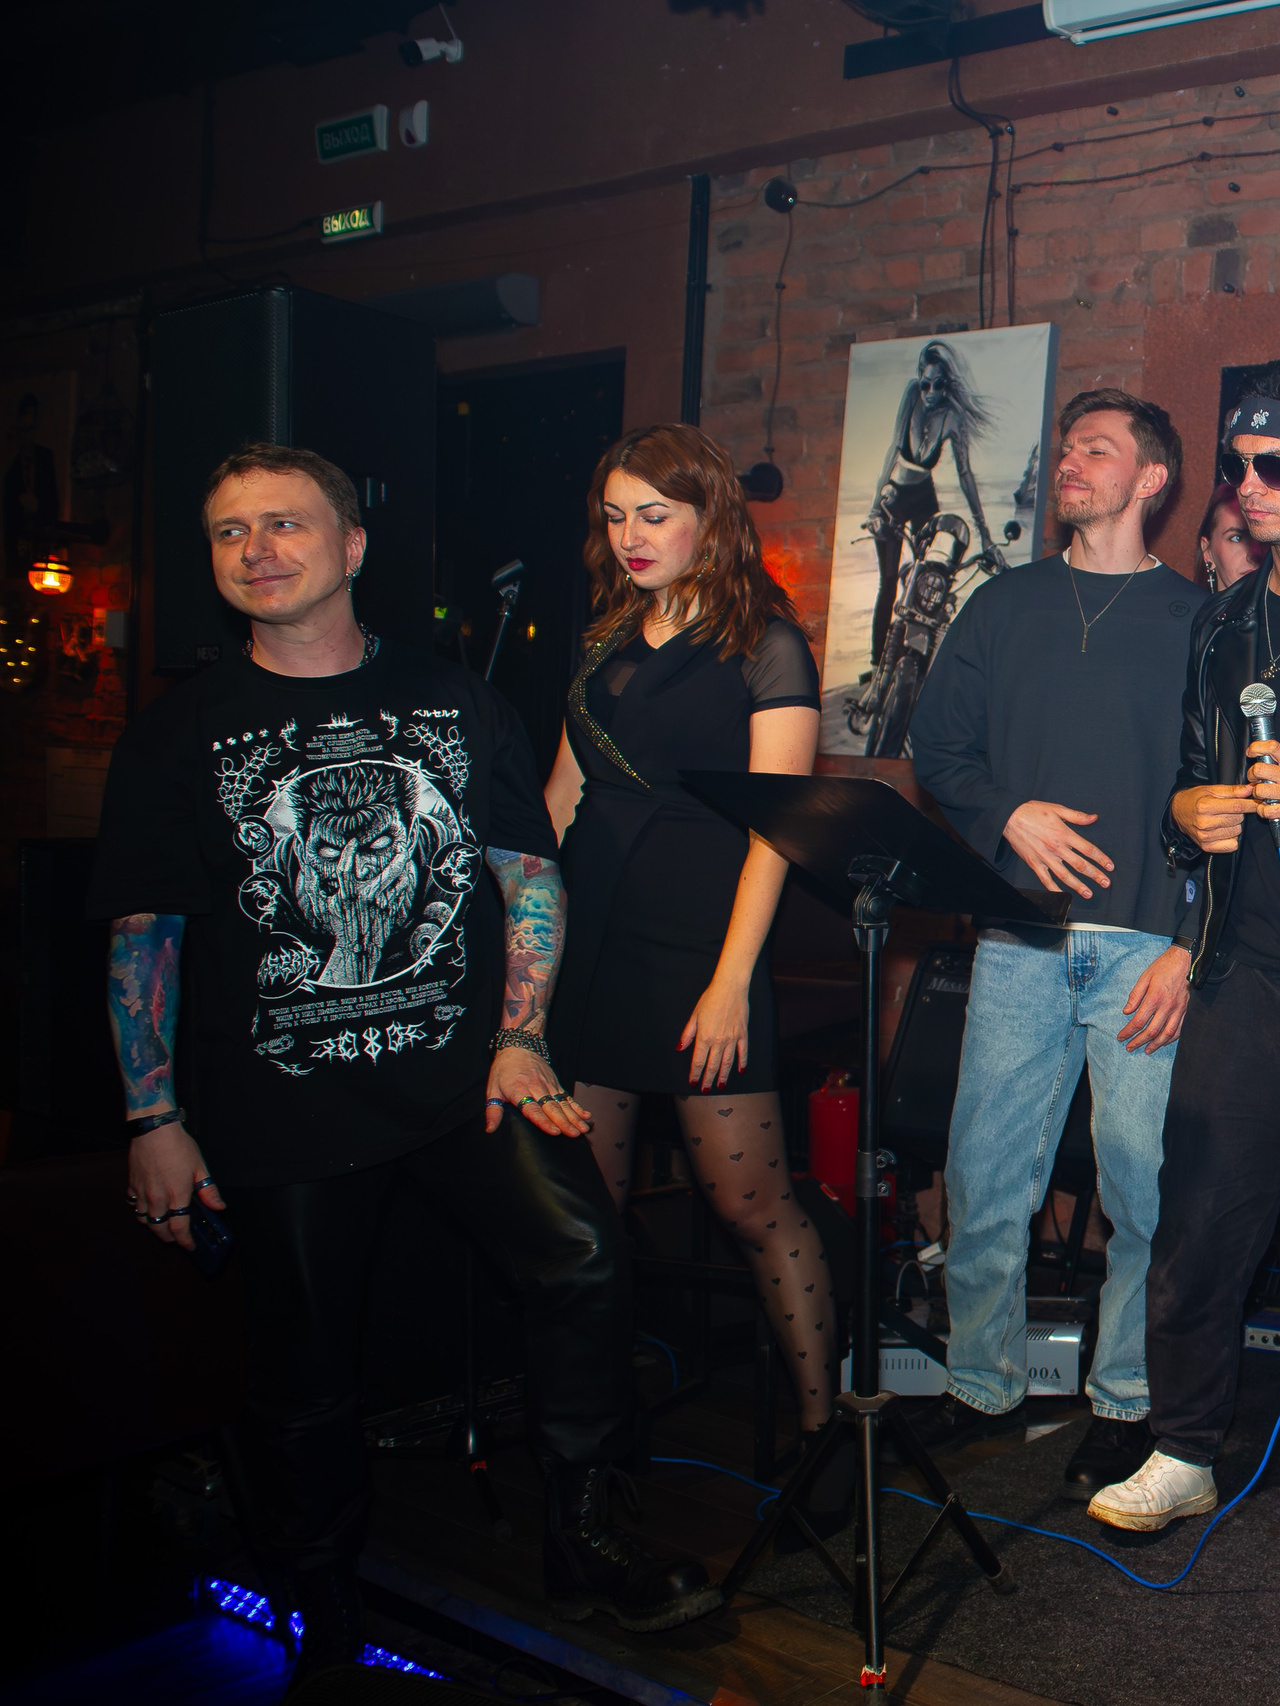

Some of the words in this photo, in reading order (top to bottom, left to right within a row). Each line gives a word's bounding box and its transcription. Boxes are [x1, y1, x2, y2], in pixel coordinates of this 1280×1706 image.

[322, 122, 372, 151] ВЫХОД
[322, 208, 371, 234] ВЫХОД
[412, 708, 460, 720] ベルセルク
